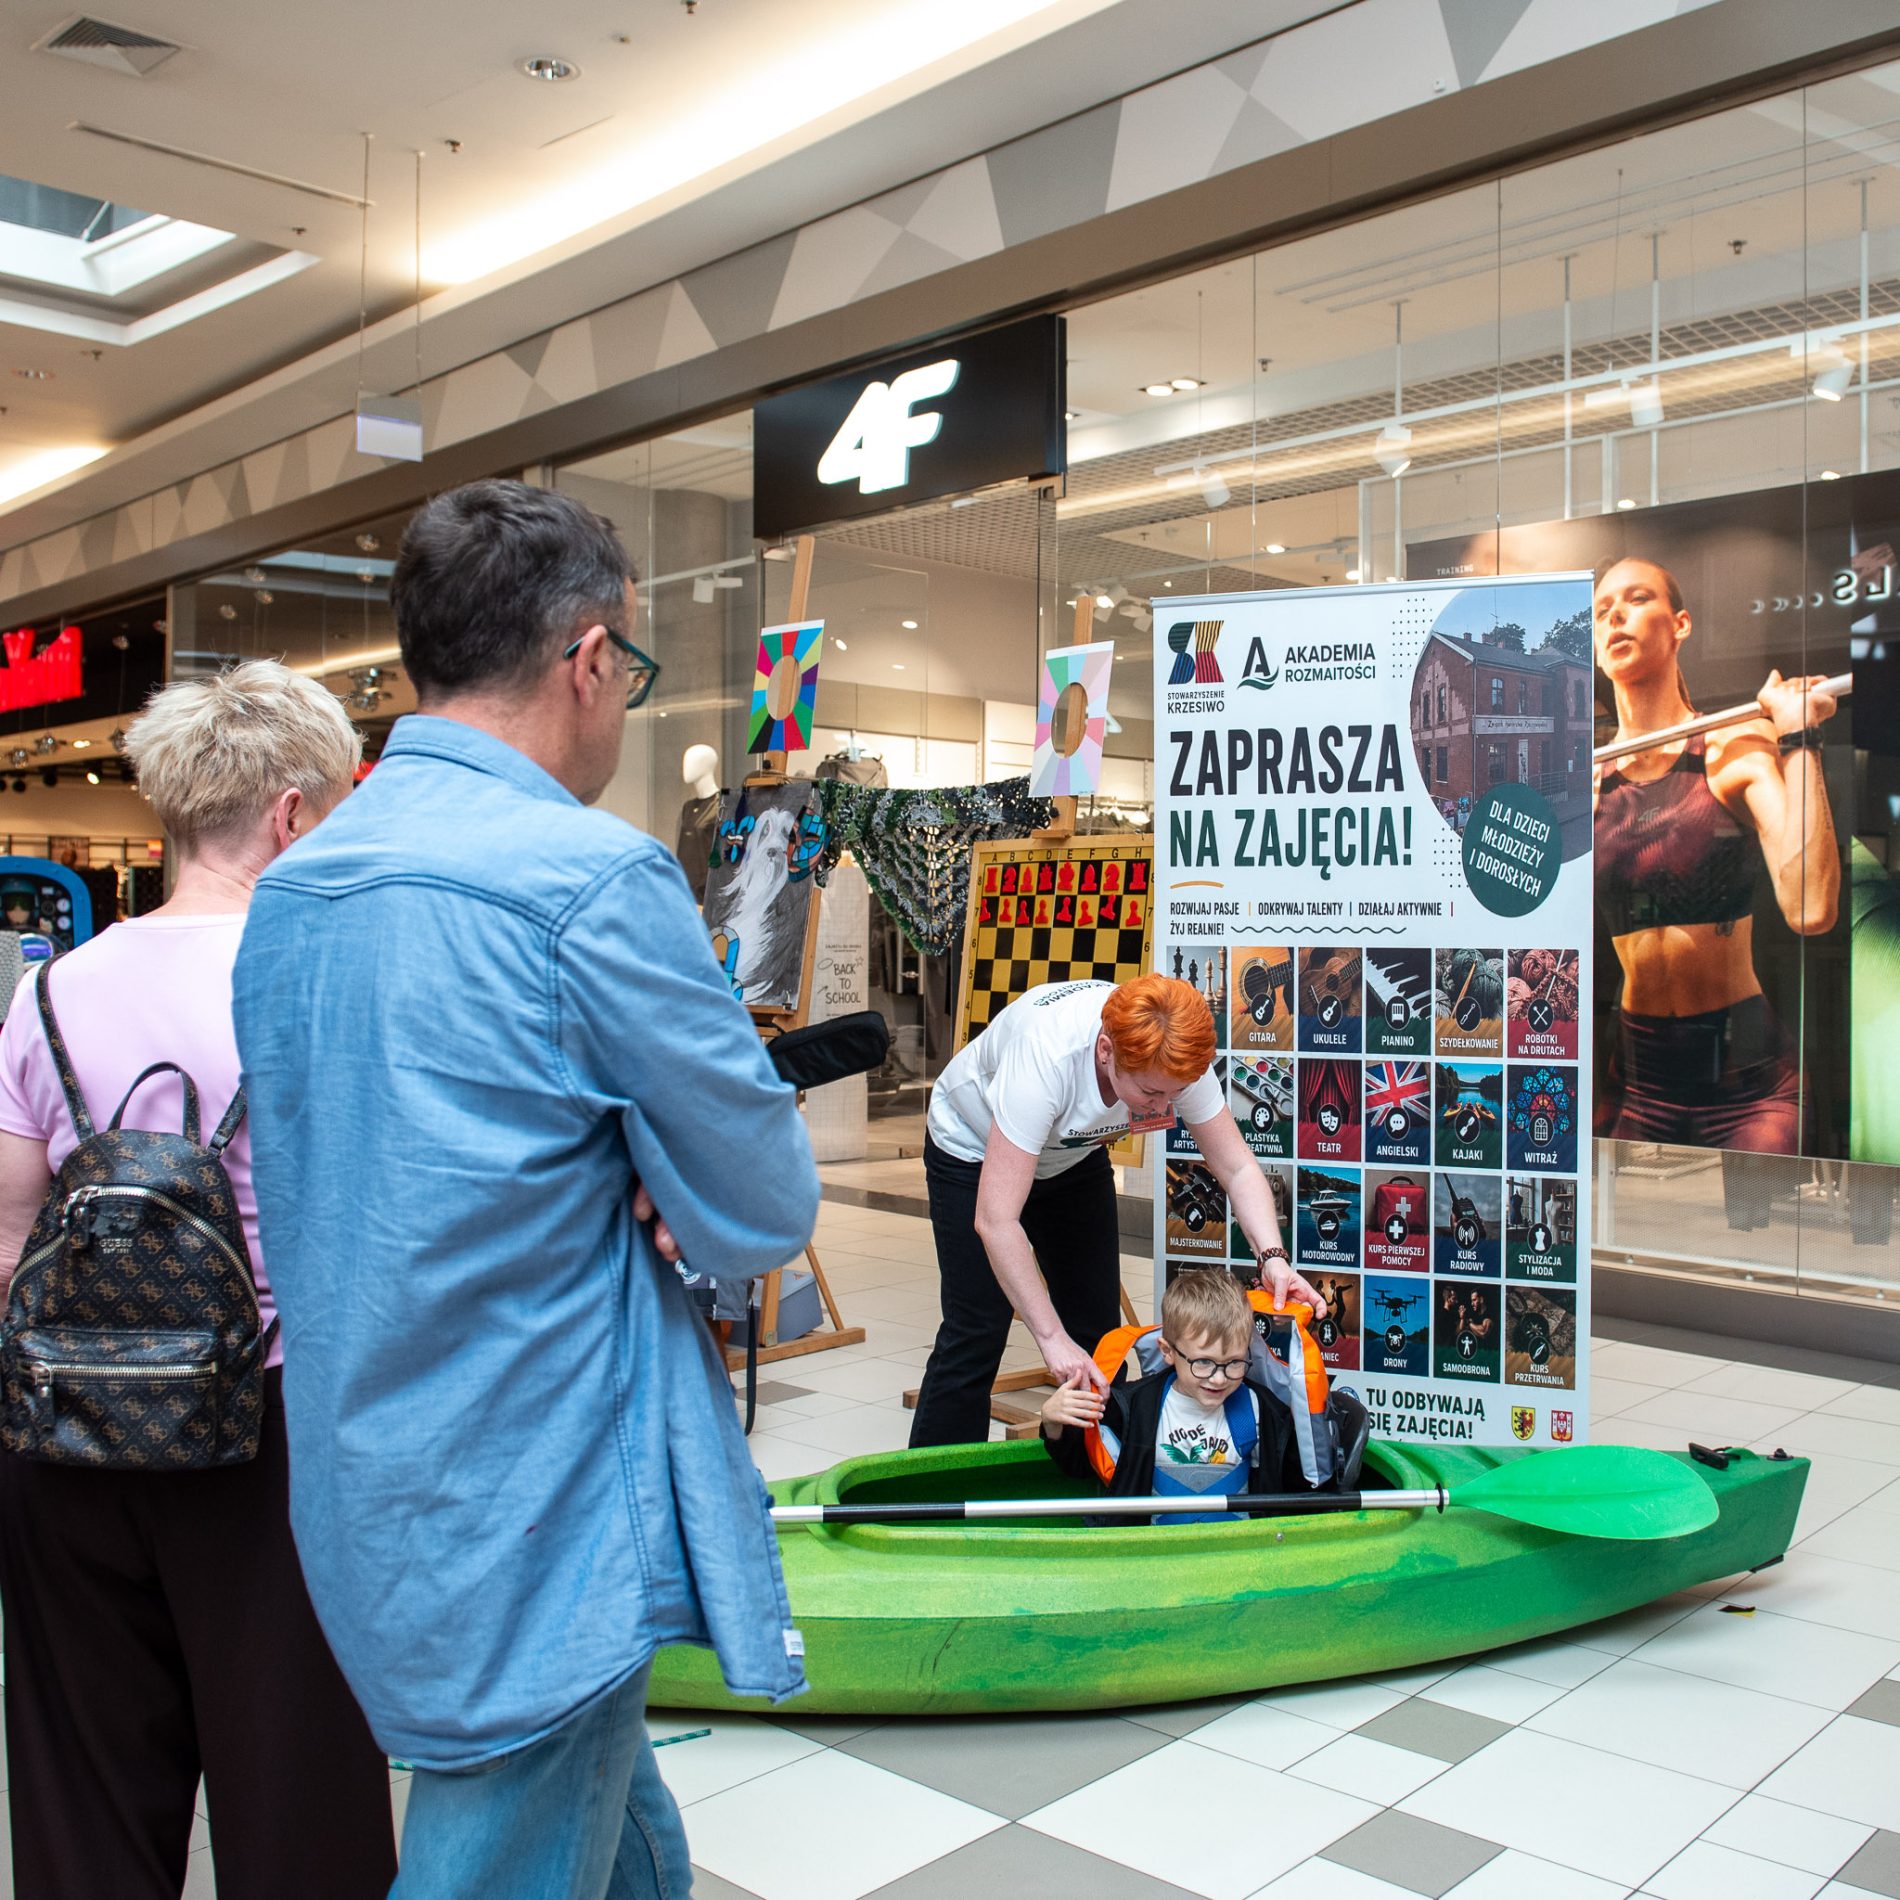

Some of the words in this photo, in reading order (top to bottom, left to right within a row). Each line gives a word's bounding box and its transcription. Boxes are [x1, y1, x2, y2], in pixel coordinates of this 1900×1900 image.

[817, 358, 960, 494] 4F
[1437, 564, 1474, 576] TRAINING
[1285, 642, 1376, 665] AKADEMIA
[1285, 662, 1376, 683] ROZMAITOŚCI
[1167, 690, 1225, 700] STOWARZYSZENIE
[1167, 700, 1225, 714] KRZESIWO
[1169, 723, 1405, 797] ZAPRASZA
[1489, 800, 1512, 826] DLA
[1513, 811, 1550, 843] DZIECI
[1170, 809, 1220, 867] NA
[1233, 806, 1412, 881] ZAJĘCIA!
[1481, 825, 1545, 869] MŁODZIEŻY
[992, 854, 998, 862] A
[1010, 852, 1015, 861] B
[1028, 850, 1033, 860] C
[1046, 850, 1052, 859] D
[1067, 849, 1073, 859] E
[1089, 848, 1095, 858] F
[1111, 848, 1119, 858] G
[1135, 848, 1142, 857] H
[1469, 848, 1476, 866] I
[1476, 852, 1542, 898] DOROSŁYCH
[975, 908, 979, 916] 7
[1148, 907, 1154, 917] 7
[1170, 902, 1212, 916] ROZWIJAJ
[1214, 903, 1240, 916] PASJE
[1258, 902, 1304, 916] ODKRYWAJ
[1306, 902, 1343, 916] TALENTY
[1358, 902, 1395, 917] DZIAŁAJ
[1397, 902, 1442, 917] AKTYWNIE
[1170, 920, 1185, 935] ŻYJ
[1187, 922, 1224, 935] REALNIE!
[972, 939, 977, 947] 6
[1144, 942, 1150, 952] 6
[833, 963, 856, 976] BACK
[839, 977, 852, 990] TO
[825, 991, 861, 1004] SCHOOL
[962, 1033, 967, 1041] 3
[1249, 1032, 1276, 1043] GITARA
[1313, 1033, 1347, 1045] UKULELE
[1381, 1035, 1415, 1047] PIANINO
[1439, 1037, 1498, 1049] SZYDEŁKOWANIE
[1518, 1045, 1529, 1055] NA
[1531, 1046, 1565, 1056] DRUTACH
[1245, 1132, 1280, 1143] PLASTYKA
[1248, 1143, 1283, 1154] REATYWNA
[1317, 1142, 1341, 1153] TEATR
[1376, 1145, 1419, 1157] ANGIELSKI
[1452, 1149, 1483, 1161] KAJAKI
[1524, 1150, 1558, 1164] WITRAŻ
[1169, 1237, 1222, 1250] MAJSTERKOWANIE
[1319, 1241, 1338, 1251] KURS
[1302, 1250, 1355, 1263] MOTOROWODNY
[1368, 1244, 1387, 1254] KURS
[1388, 1246, 1425, 1257] PIERWSZEJ
[1457, 1250, 1477, 1260] KURS
[1381, 1255, 1411, 1266] POMOCY
[1450, 1259, 1484, 1272] RADIOWY
[1518, 1254, 1562, 1266] STYLIZACJA
[1531, 1266, 1554, 1277] MODA
[1321, 1352, 1339, 1363] ANIEC
[1383, 1357, 1408, 1369] DRONY
[1442, 1362, 1491, 1376] SAMOOBRONA
[1530, 1363, 1549, 1374] KURS
[1514, 1372, 1565, 1386] PRZETRWANIA
[1366, 1388, 1386, 1407] TU
[1392, 1390, 1485, 1422] ODBYWAJĄ
[1187, 1423, 1206, 1441] DE
[1368, 1412, 1391, 1436] SIĘ
[1396, 1415, 1473, 1441] ZAJĘCIA!
